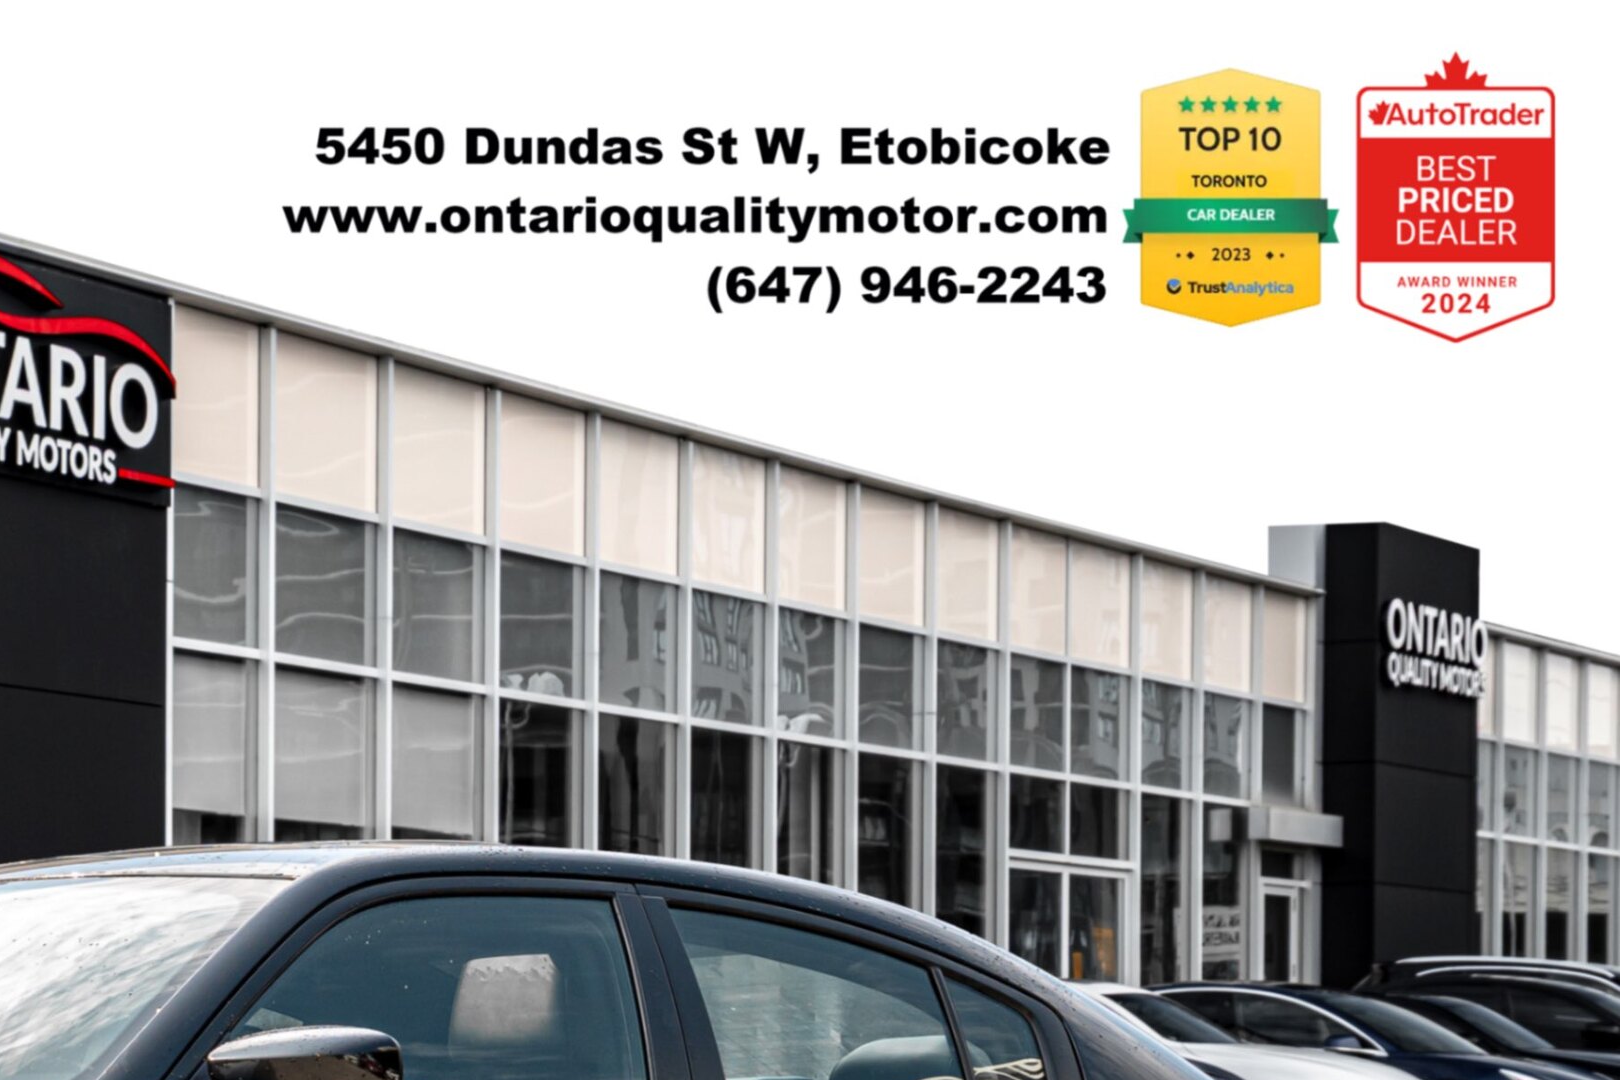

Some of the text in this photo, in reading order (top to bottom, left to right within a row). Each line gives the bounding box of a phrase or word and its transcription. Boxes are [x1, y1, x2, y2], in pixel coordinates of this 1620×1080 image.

[16, 431, 118, 484] MOTORS
[1387, 598, 1488, 668] ONTARIO
[1387, 651, 1485, 699] QUALITY MOTORS
